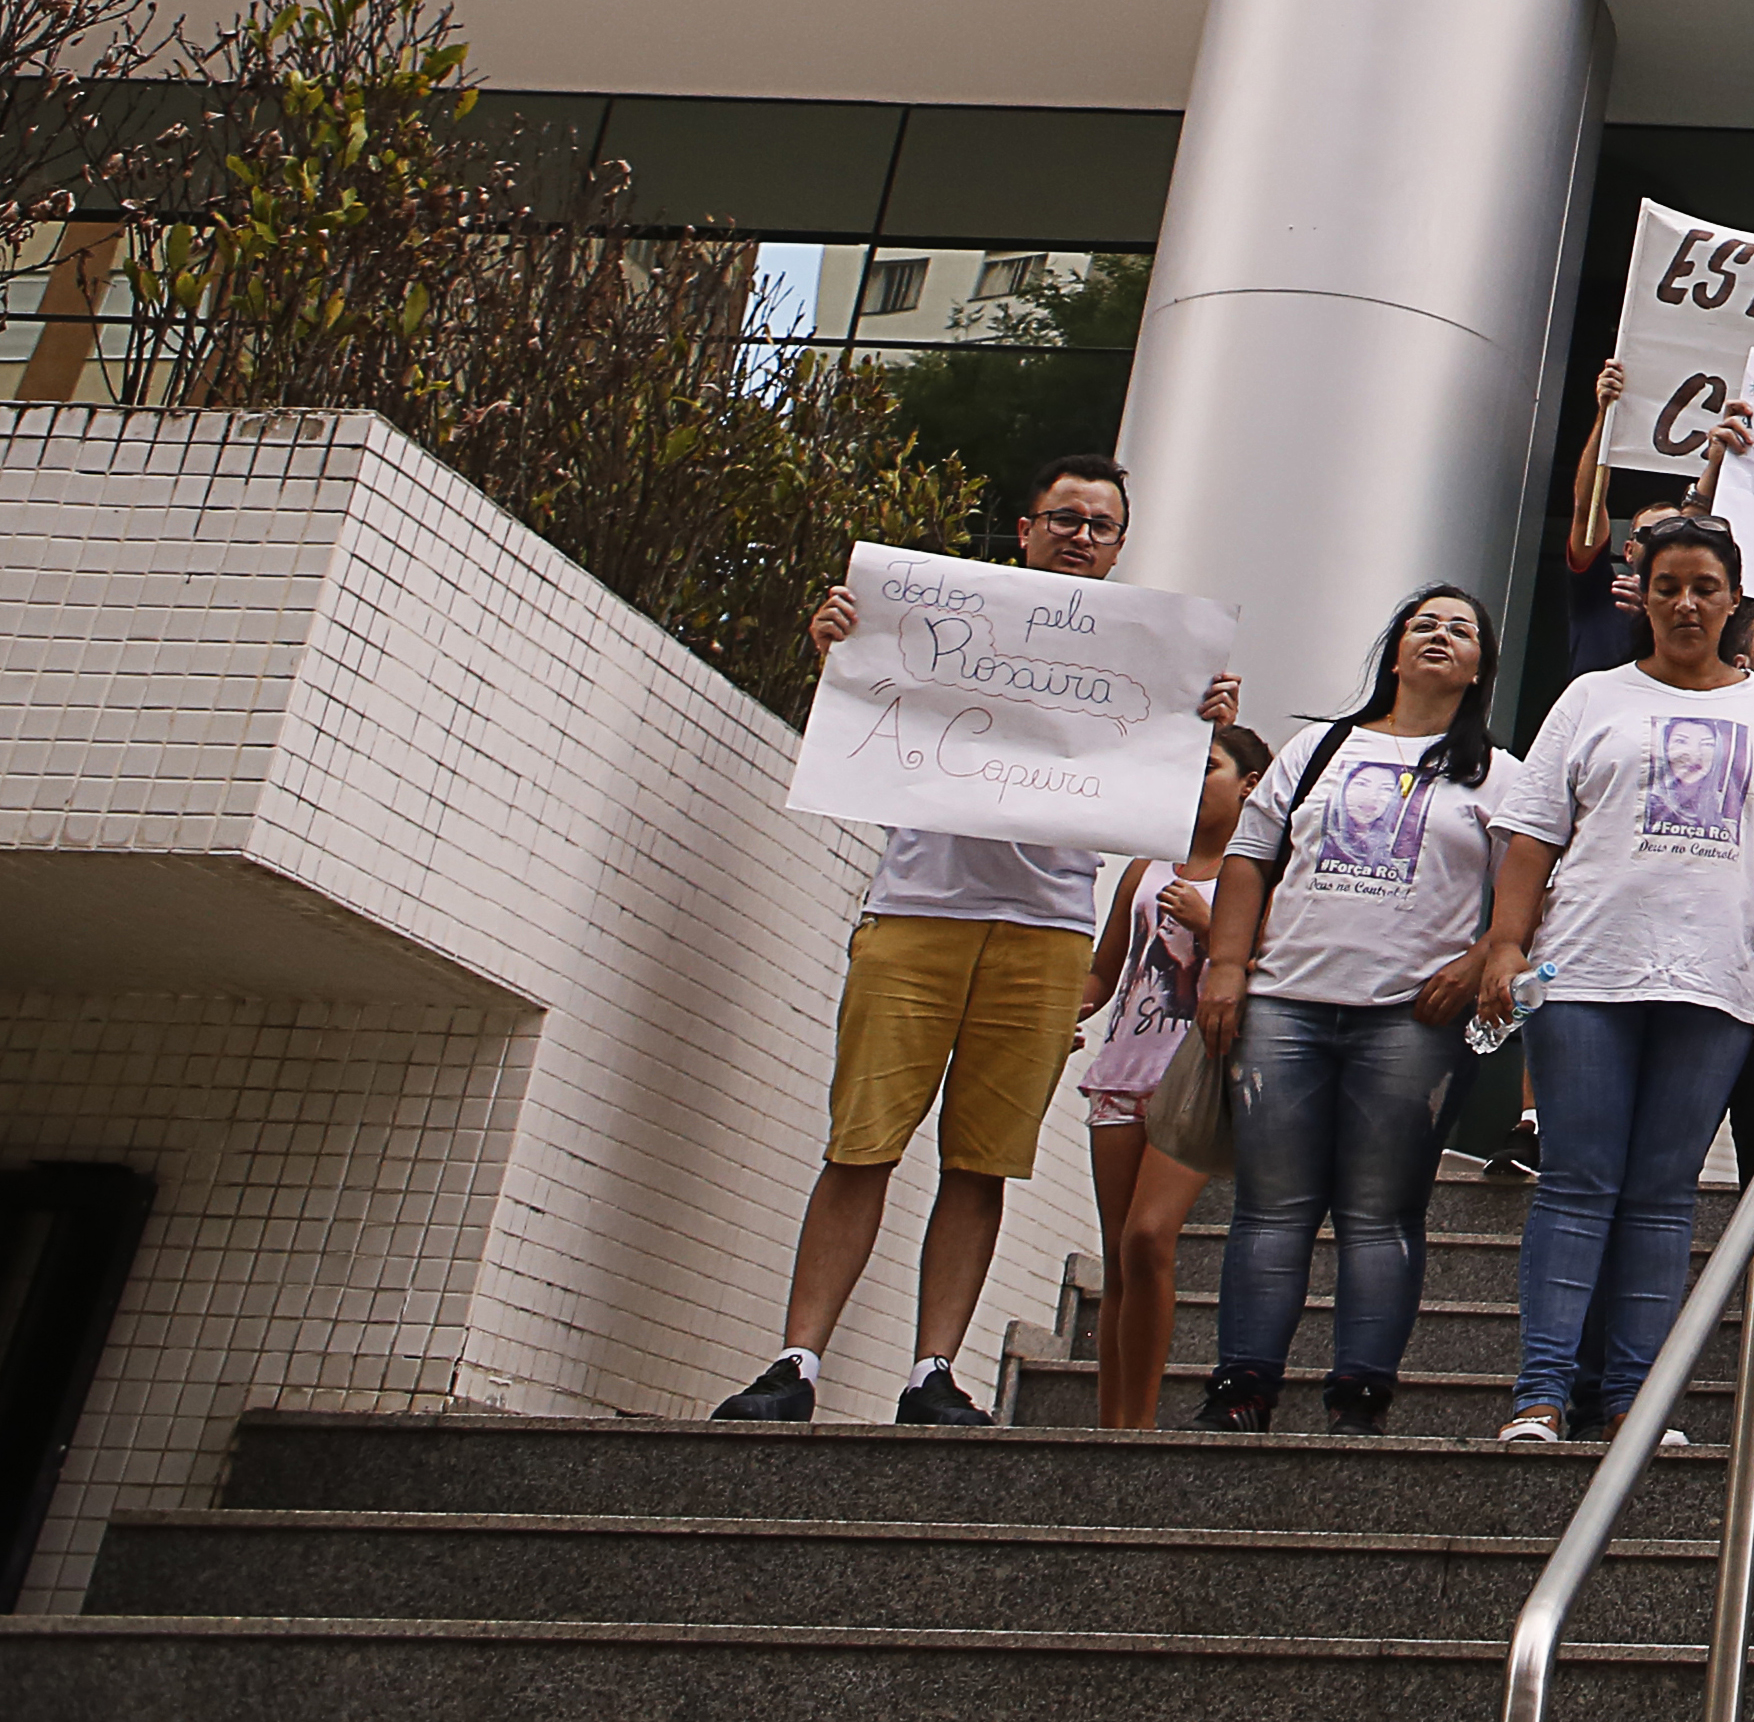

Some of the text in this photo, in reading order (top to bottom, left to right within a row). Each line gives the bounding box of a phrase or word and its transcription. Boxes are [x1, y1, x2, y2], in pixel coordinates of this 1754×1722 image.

[882, 559, 1096, 643] Todos pela
[924, 617, 1112, 705] Rosaira
[847, 695, 925, 770] A
[1639, 839, 1667, 853] Deus
[1671, 844, 1686, 854] no
[1652, 821, 1705, 837] #Força
[1321, 859, 1372, 876] #Força
